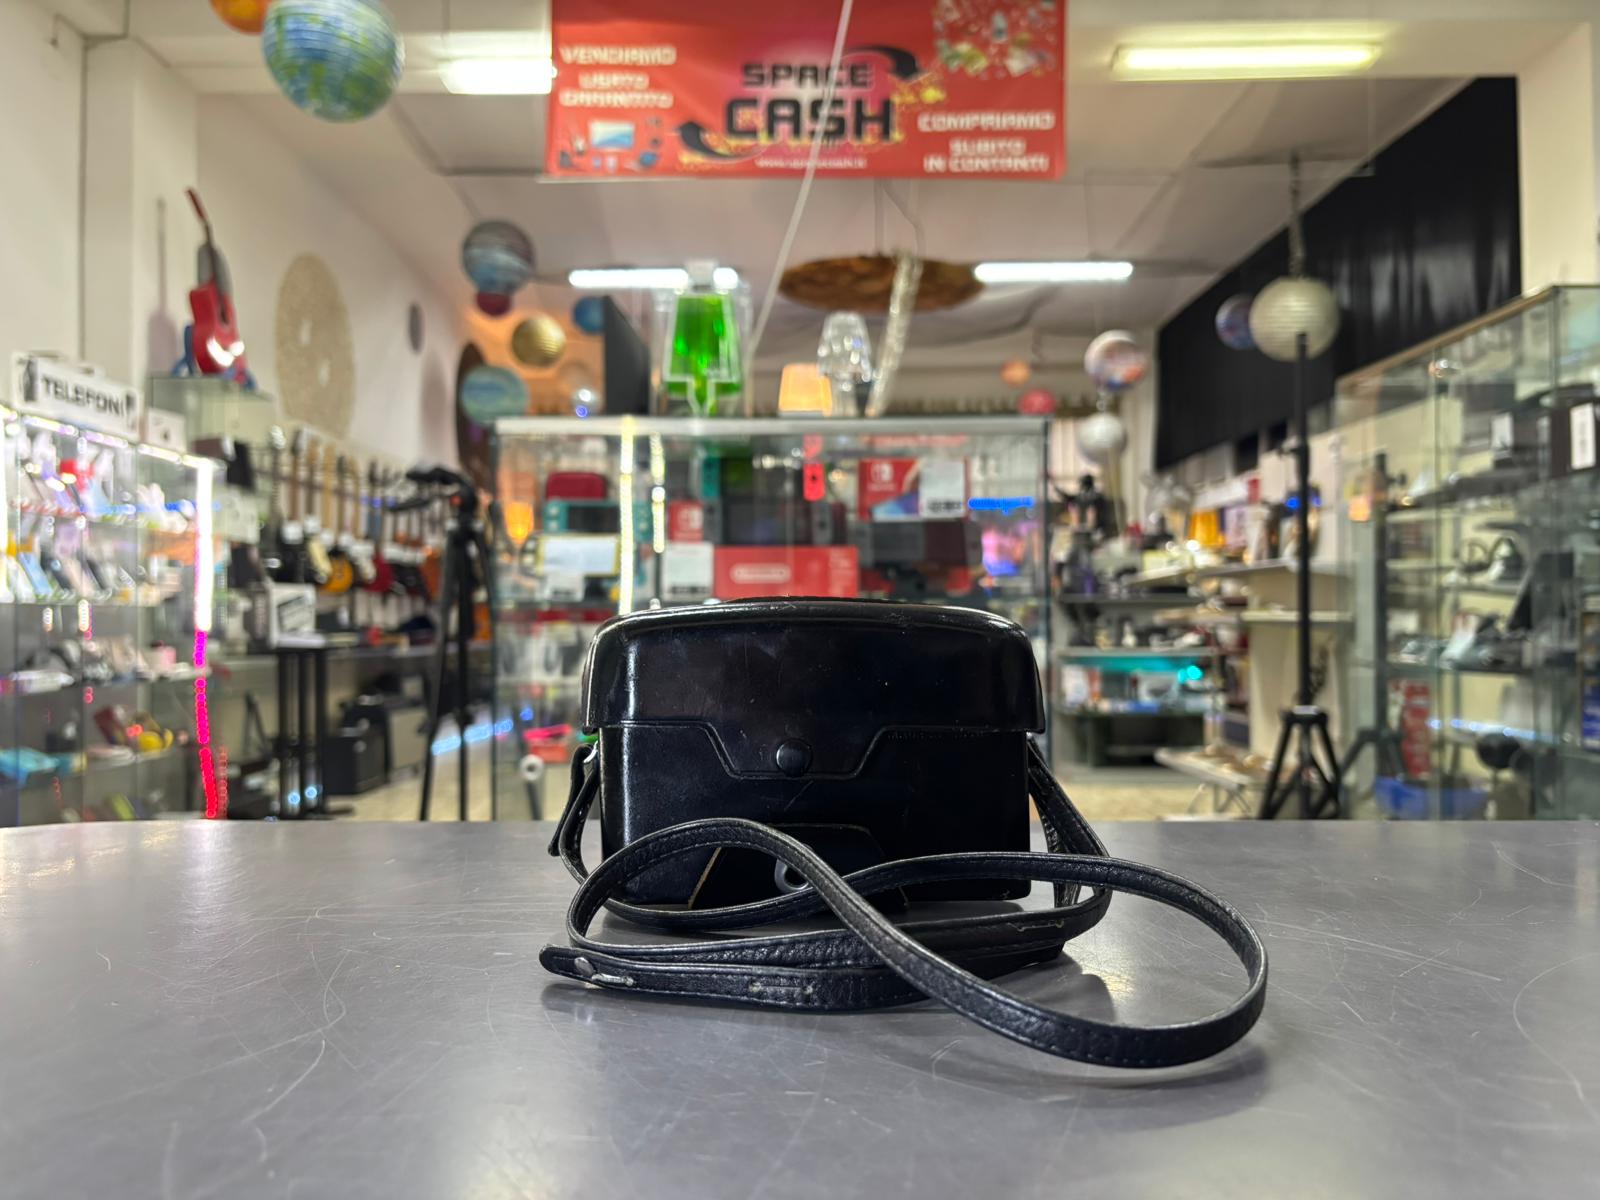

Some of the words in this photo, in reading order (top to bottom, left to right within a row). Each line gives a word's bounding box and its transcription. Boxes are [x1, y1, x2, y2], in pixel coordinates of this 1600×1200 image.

[743, 64, 870, 88] SPACE
[726, 98, 893, 141] CASH
[923, 154, 947, 173] IN
[42, 375, 125, 418] TELEFONI
